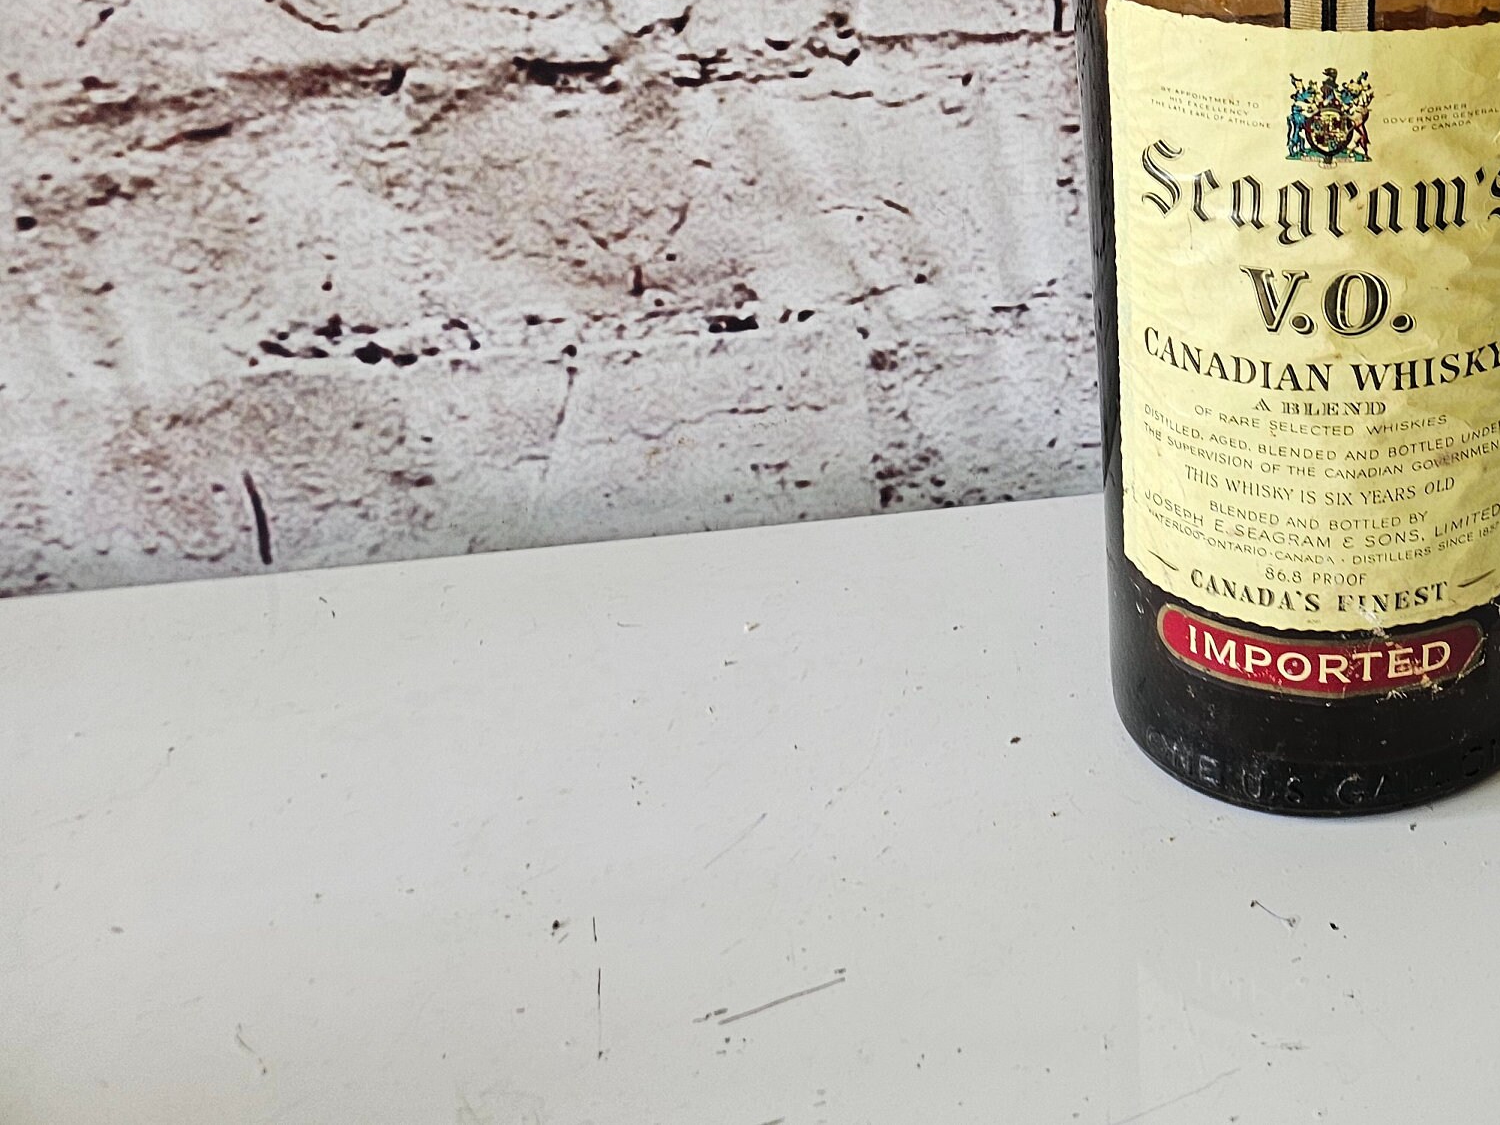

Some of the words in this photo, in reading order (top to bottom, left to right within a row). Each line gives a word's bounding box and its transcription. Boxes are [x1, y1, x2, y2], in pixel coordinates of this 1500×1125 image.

[1175, 88, 1240, 106] APPOINTMENT
[1247, 101, 1260, 109] TO
[1187, 100, 1248, 116] EXCELLENCY
[1420, 103, 1467, 114] FORMER
[1383, 114, 1448, 124] GOVERNOR
[1452, 107, 1499, 118] GENERAL
[1431, 119, 1471, 131] CANADA
[1240, 265, 1416, 339] V.O.
[1144, 326, 1333, 392] CANADIAN
[1194, 404, 1213, 417] OF
[1218, 412, 1261, 429] RARE
[1269, 419, 1354, 436] SELECTED
[1365, 414, 1447, 435] WHISKIES
[1251, 397, 1273, 413] A
[1281, 401, 1387, 416] BLEND
[1143, 421, 1162, 442] THE
[1167, 435, 1253, 470] SUPERVISION
[1260, 462, 1281, 474] OF
[1287, 465, 1316, 477] THE
[1324, 464, 1403, 480] CANADIAN
[1258, 443, 1337, 460] BLENDED
[1344, 449, 1379, 461] AND
[1388, 436, 1454, 458] BOTTLED
[1184, 464, 1219, 489] THIS
[1225, 478, 1294, 501] WHISKY
[1300, 489, 1316, 506] IS
[1324, 490, 1354, 506] SIX
[1359, 485, 1416, 505] YEARS
[1424, 476, 1455, 495] OLD
[1144, 490, 1204, 527] JOSEPH
[1234, 524, 1331, 548] SEAGRAM
[1342, 536, 1354, 549] &
[1434, 502, 1500, 537] LIMITED
[1209, 500, 1279, 526] BLENDED
[1286, 516, 1320, 530] AND
[1329, 516, 1401, 532] BOTTLED
[1409, 510, 1428, 524] BY
[1352, 546, 1432, 565] DISTILLERS
[1437, 531, 1474, 552] SINCE
[1190, 568, 1320, 612] CANADA'S
[1337, 581, 1448, 613] FINEST
[1265, 566, 1302, 584] 86.8
[1312, 572, 1368, 587] PROOF
[1187, 623, 1452, 685] IMPORTED
